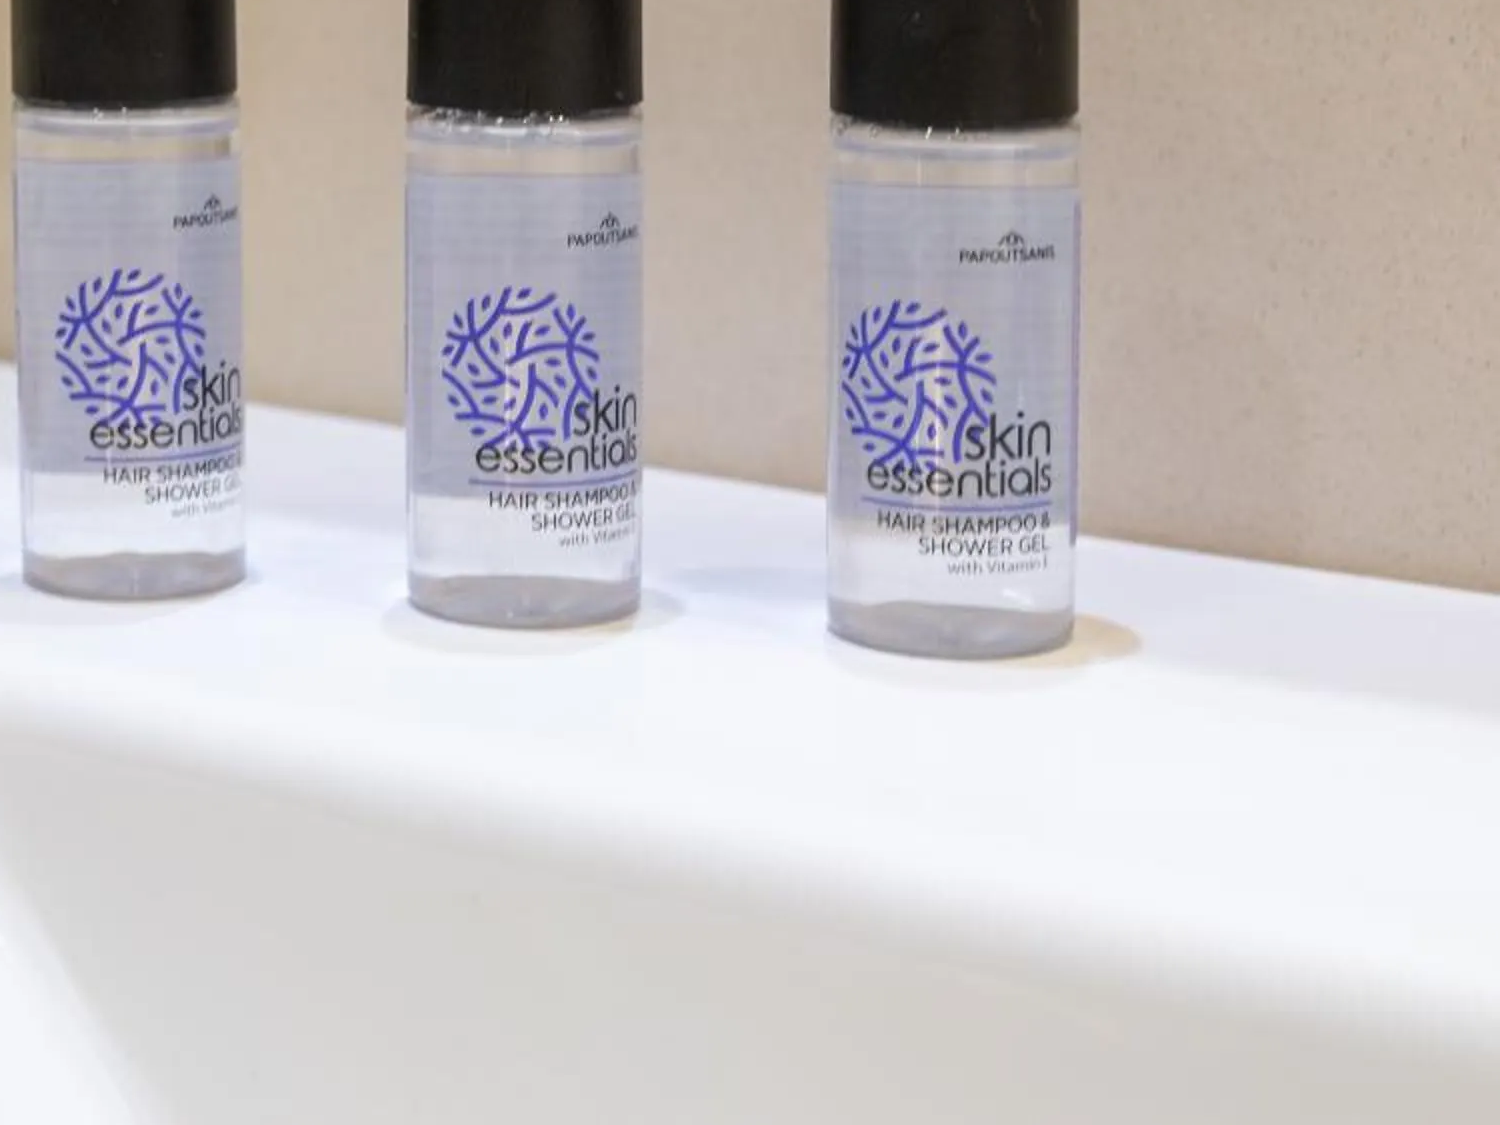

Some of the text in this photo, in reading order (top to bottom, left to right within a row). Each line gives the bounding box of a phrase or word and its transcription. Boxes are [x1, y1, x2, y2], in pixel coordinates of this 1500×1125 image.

[182, 360, 241, 411] skin
[573, 384, 637, 438] skin
[90, 401, 242, 449] essentials
[964, 411, 1051, 461] skin
[475, 430, 637, 475] essentials
[103, 466, 151, 484] HAIR
[867, 456, 1052, 499] essentials
[145, 476, 221, 505] SHOWER
[489, 491, 537, 509] HAIR
[545, 483, 629, 509] SHAMPOO
[532, 508, 613, 531] SHOWER
[877, 509, 925, 531] HAIR
[932, 515, 1037, 535] SHAMPOO
[560, 533, 589, 548] with
[918, 533, 1050, 557] SHOWER GEL
[948, 559, 983, 574] with
